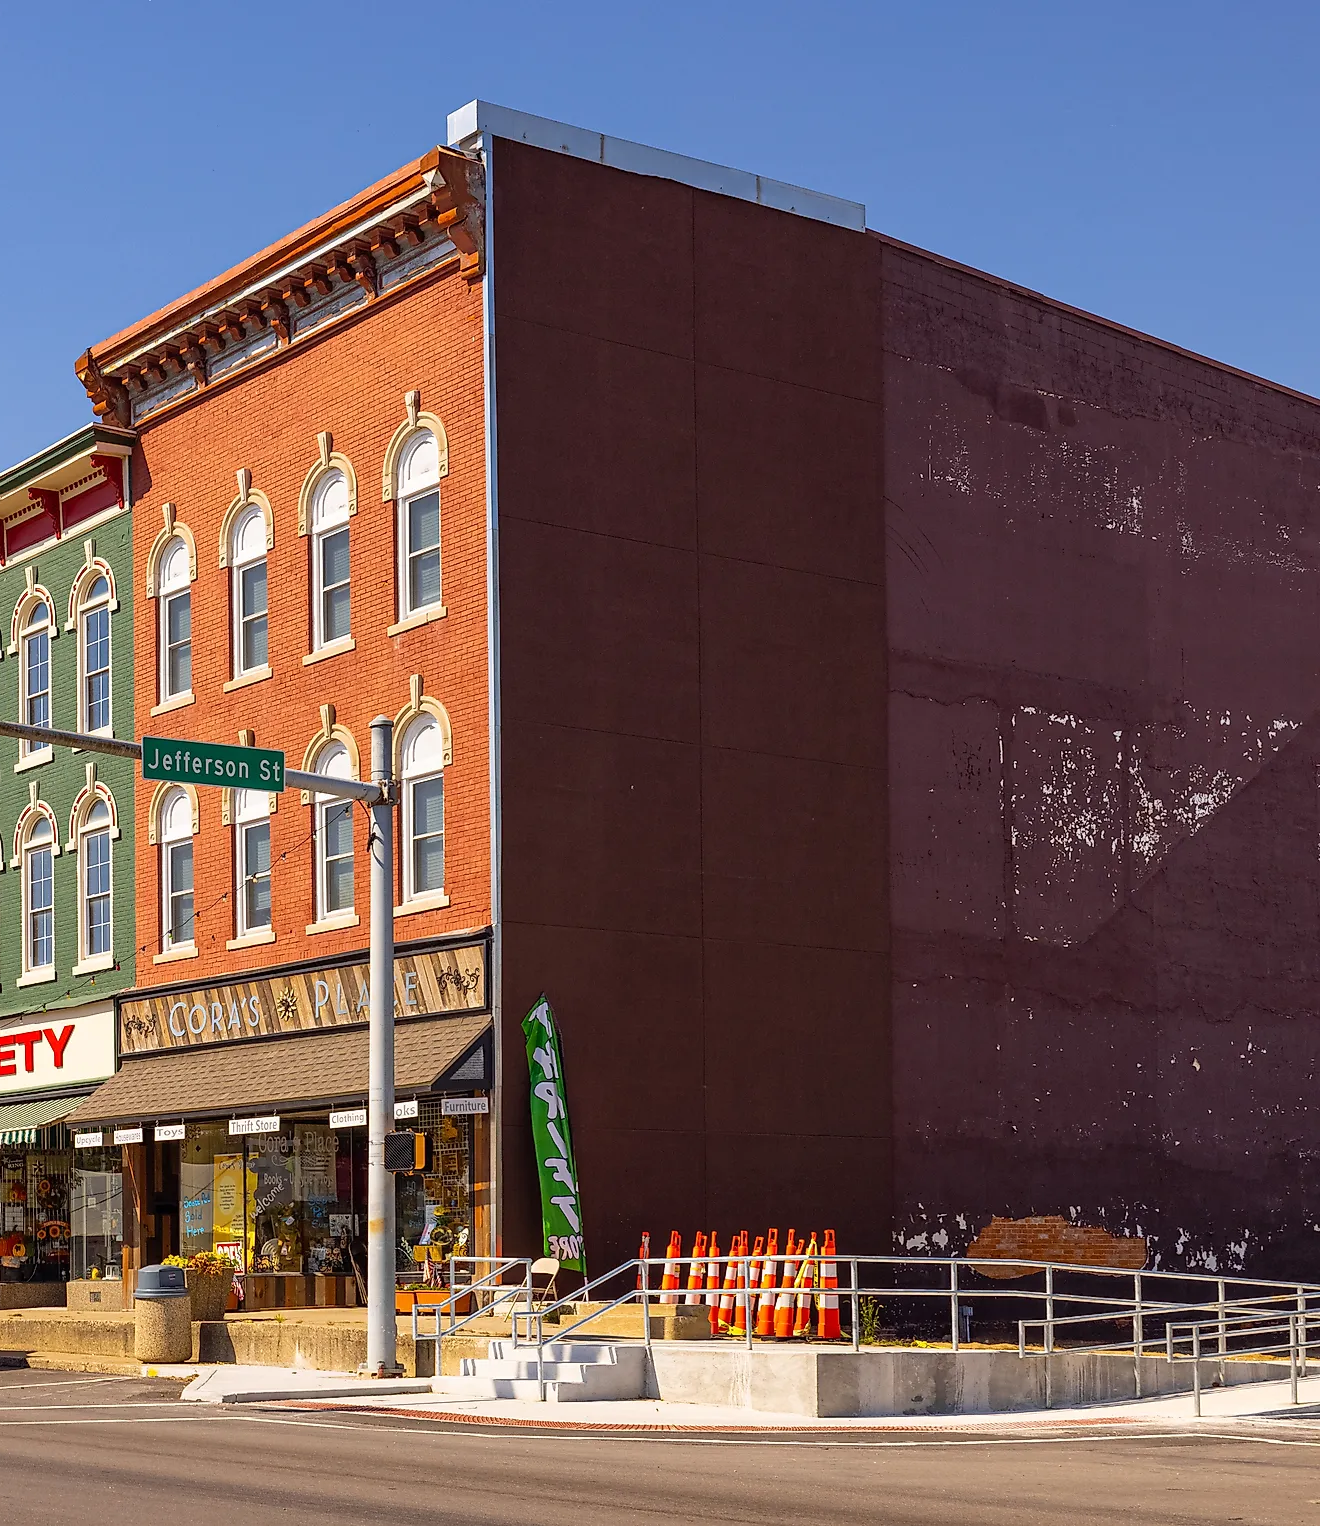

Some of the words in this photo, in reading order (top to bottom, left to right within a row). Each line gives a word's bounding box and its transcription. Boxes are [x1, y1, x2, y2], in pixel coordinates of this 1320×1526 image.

[148, 748, 249, 779] Jefferson
[259, 759, 281, 782] St
[169, 995, 260, 1037] CORA'S
[315, 971, 417, 1019] PLAE
[395, 1104, 416, 1117] oks
[444, 1100, 486, 1112] Furniture
[331, 1112, 365, 1124] Clothing
[156, 1128, 184, 1138] Toys
[231, 1121, 254, 1133] Thrift
[256, 1119, 278, 1132] Store
[76, 1135, 101, 1146] Upcycle
[258, 1130, 301, 1153] Cora's
[304, 1131, 340, 1153] Place
[263, 1173, 282, 1185] Books
[250, 1182, 285, 1220] welcome
[184, 1208, 202, 1223] Sold
[186, 1225, 205, 1239] Here
